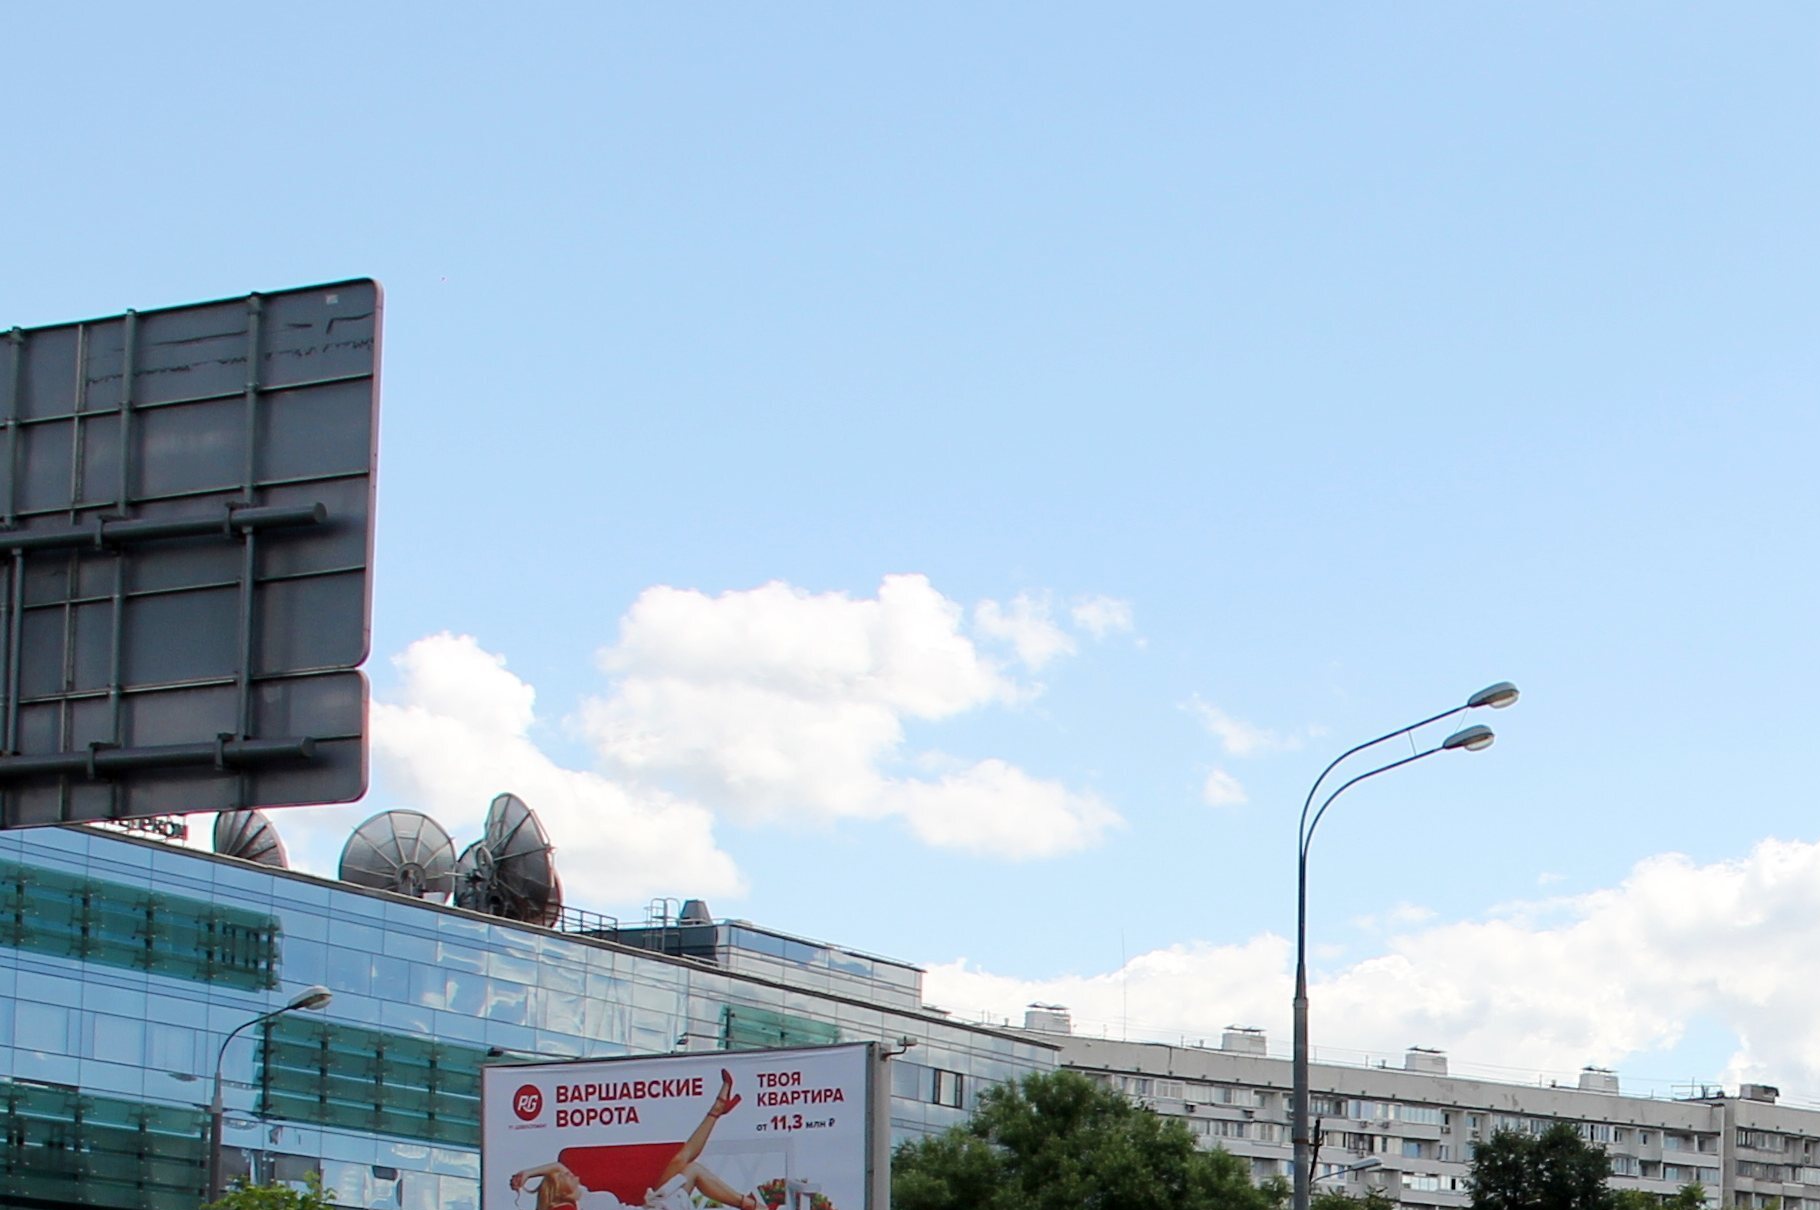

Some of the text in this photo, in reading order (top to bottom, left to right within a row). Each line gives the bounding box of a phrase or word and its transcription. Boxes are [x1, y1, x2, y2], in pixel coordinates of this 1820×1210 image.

[757, 1072, 801, 1088] ТВОЯ
[556, 1078, 703, 1104] ВАРШАВСКИЕ
[757, 1088, 844, 1107] КВАРТИРА
[556, 1106, 639, 1128] ВОРОТА
[756, 1123, 768, 1131] от
[771, 1114, 803, 1132] 11,3
